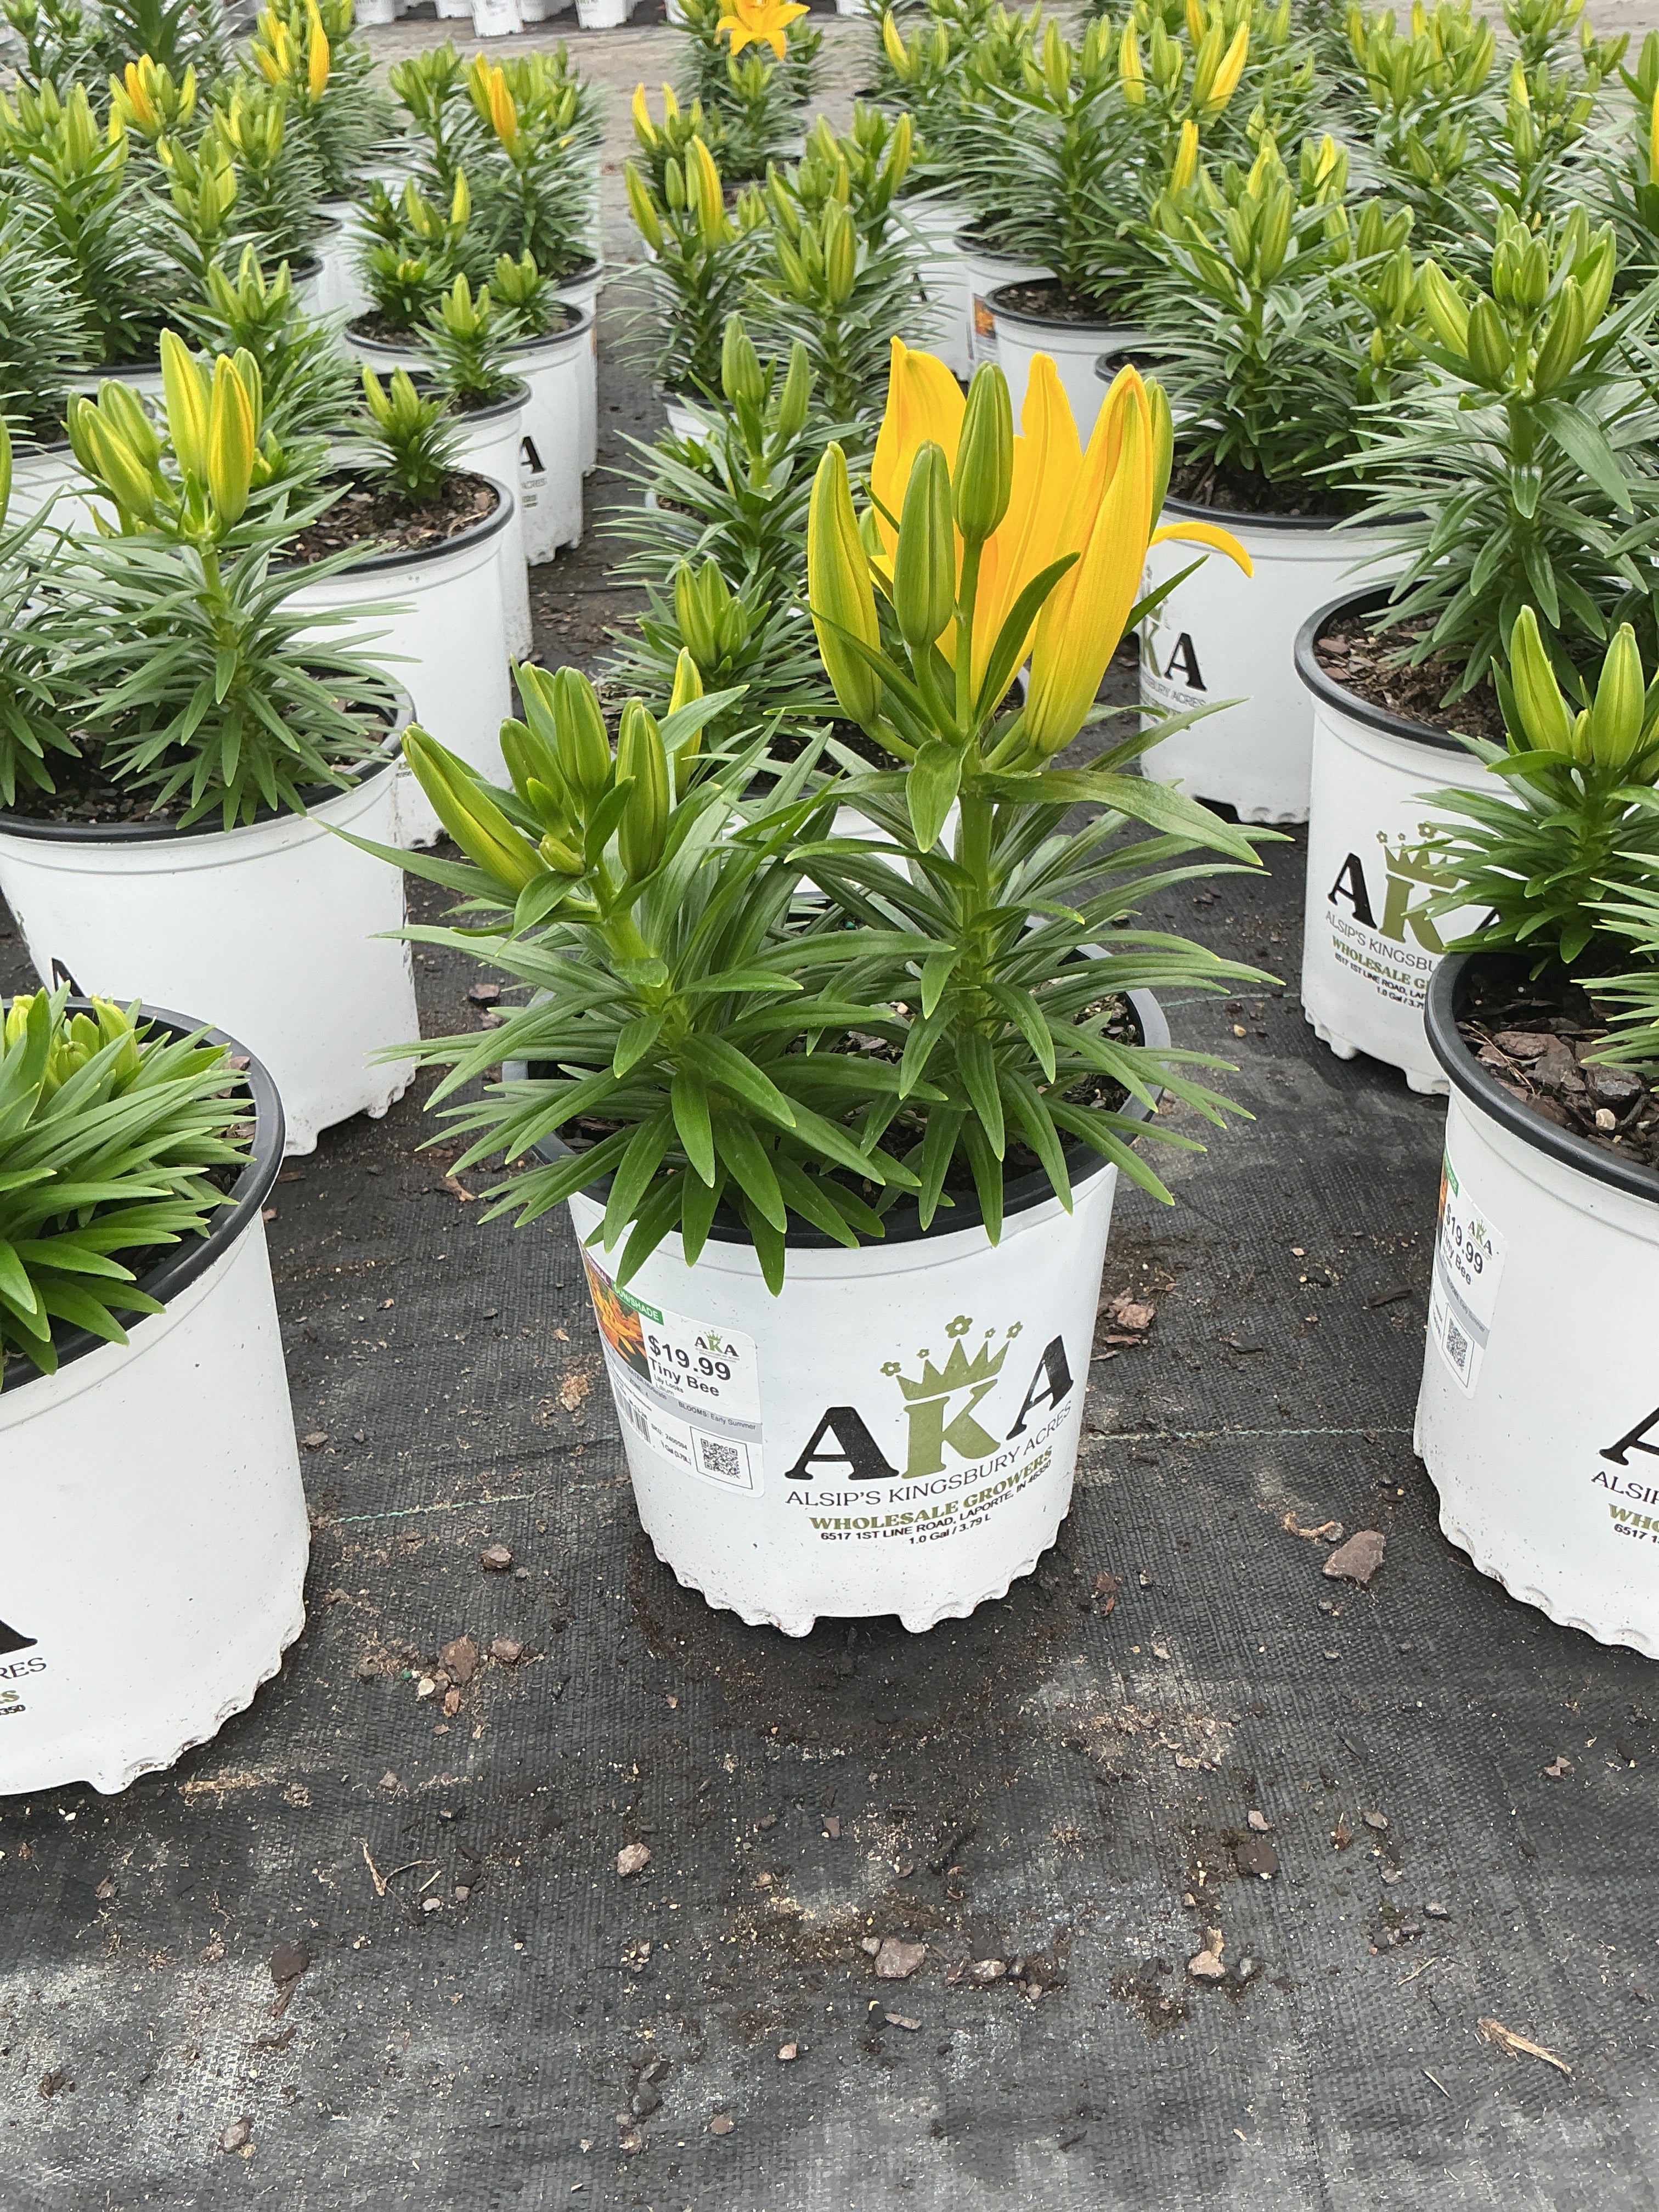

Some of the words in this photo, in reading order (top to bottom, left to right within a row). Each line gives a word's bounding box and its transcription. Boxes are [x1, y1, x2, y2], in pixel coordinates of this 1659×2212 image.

[1328, 853, 1503, 955] AK
[1325, 911, 1366, 946] ALSIP'S
[1332, 934, 1411, 986] WHOLESALE
[1446, 1203, 1483, 1274] $19.99
[1468, 1220, 1492, 1256] AKA
[1455, 1254, 1471, 1285] Bee
[648, 1335, 731, 1381] $19.99
[694, 1335, 740, 1357] AKA
[648, 1356, 681, 1385] Tiny
[686, 1375, 720, 1397] Bee
[710, 1413, 726, 1425] Early
[727, 1419, 757, 1430] Summer
[785, 1334, 1074, 1481] AKA
[785, 1491, 881, 1506] ALSIP'S
[889, 1446, 1020, 1503] KINGSBURY
[1023, 1400, 1071, 1455] ACRES
[809, 1500, 959, 1530] WHOLESALE
[963, 1445, 1053, 1509] GROWERS
[821, 1532, 850, 1541] 6517
[856, 1531, 879, 1539] 1ST
[883, 1525, 913, 1537] LINE
[1016, 1481, 1026, 1493] IN
[1028, 1459, 1051, 1483] 46350
[909, 1535, 927, 1544] 1.0
[929, 1528, 950, 1541] Gal
[959, 1517, 983, 1532] 3.79
[985, 1513, 991, 1521] L
[1614, 1523, 1648, 1540] 6517
